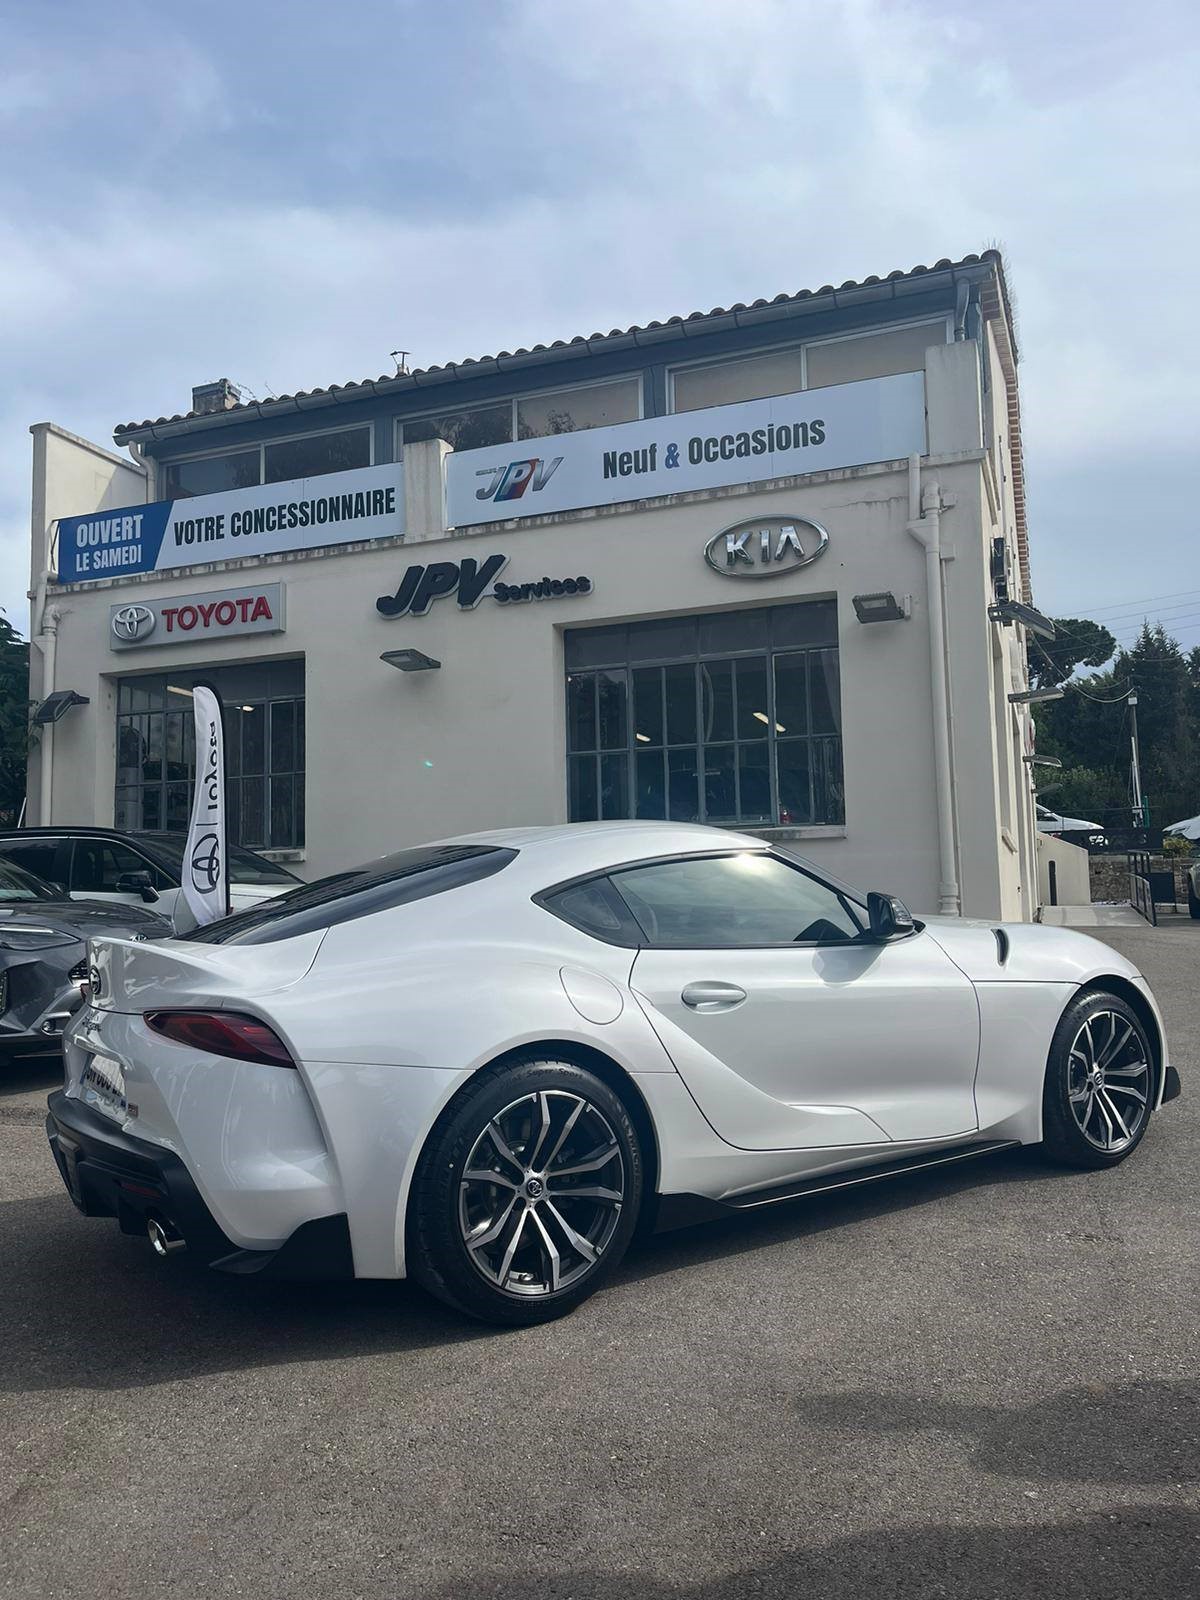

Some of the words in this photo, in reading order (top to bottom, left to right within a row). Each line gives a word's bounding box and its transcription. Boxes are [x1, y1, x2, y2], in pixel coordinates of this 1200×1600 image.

[603, 443, 657, 480] Neuf
[664, 442, 681, 469] &
[688, 418, 826, 466] Occasions
[475, 457, 564, 503] JPV
[76, 513, 144, 548] OUVERT
[174, 514, 225, 547] VOTRE
[230, 487, 396, 538] CONCESSIONNAIRE
[75, 553, 90, 573] LE
[92, 545, 142, 572] SAMEDI
[725, 525, 806, 566] KIA
[375, 553, 511, 620] JPV
[161, 596, 273, 633] TOYOTA
